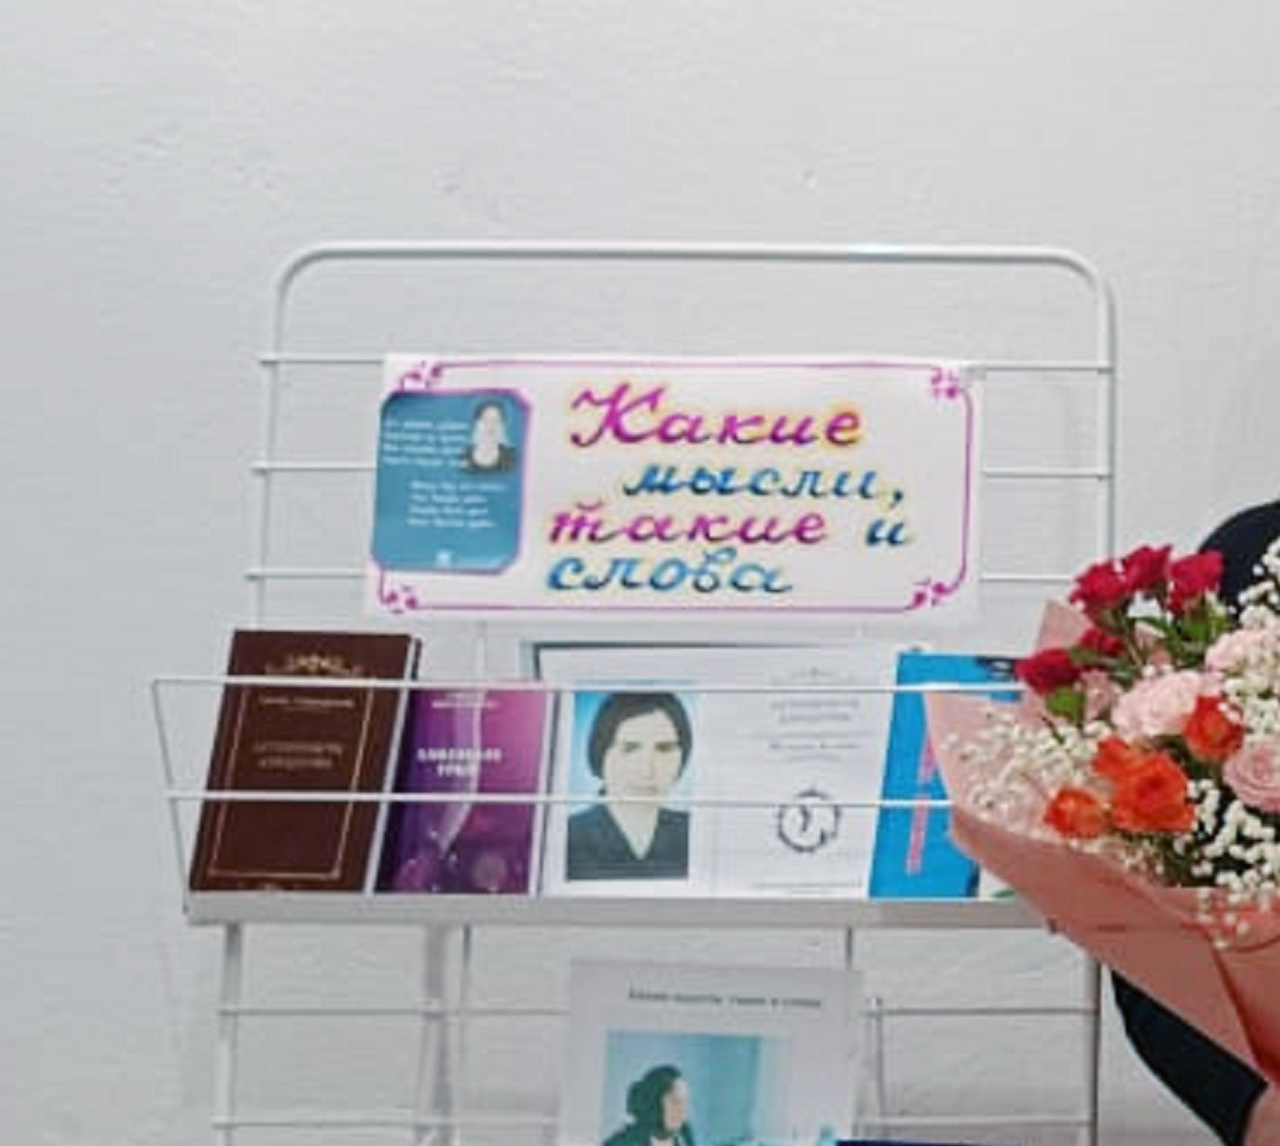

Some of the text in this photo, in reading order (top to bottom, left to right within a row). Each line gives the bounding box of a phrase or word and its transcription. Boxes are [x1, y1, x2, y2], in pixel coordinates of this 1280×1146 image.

[569, 382, 866, 448] Какие
[620, 459, 906, 506] мысли,
[546, 500, 828, 546] такие
[864, 515, 912, 547] и
[545, 546, 795, 595] слова
